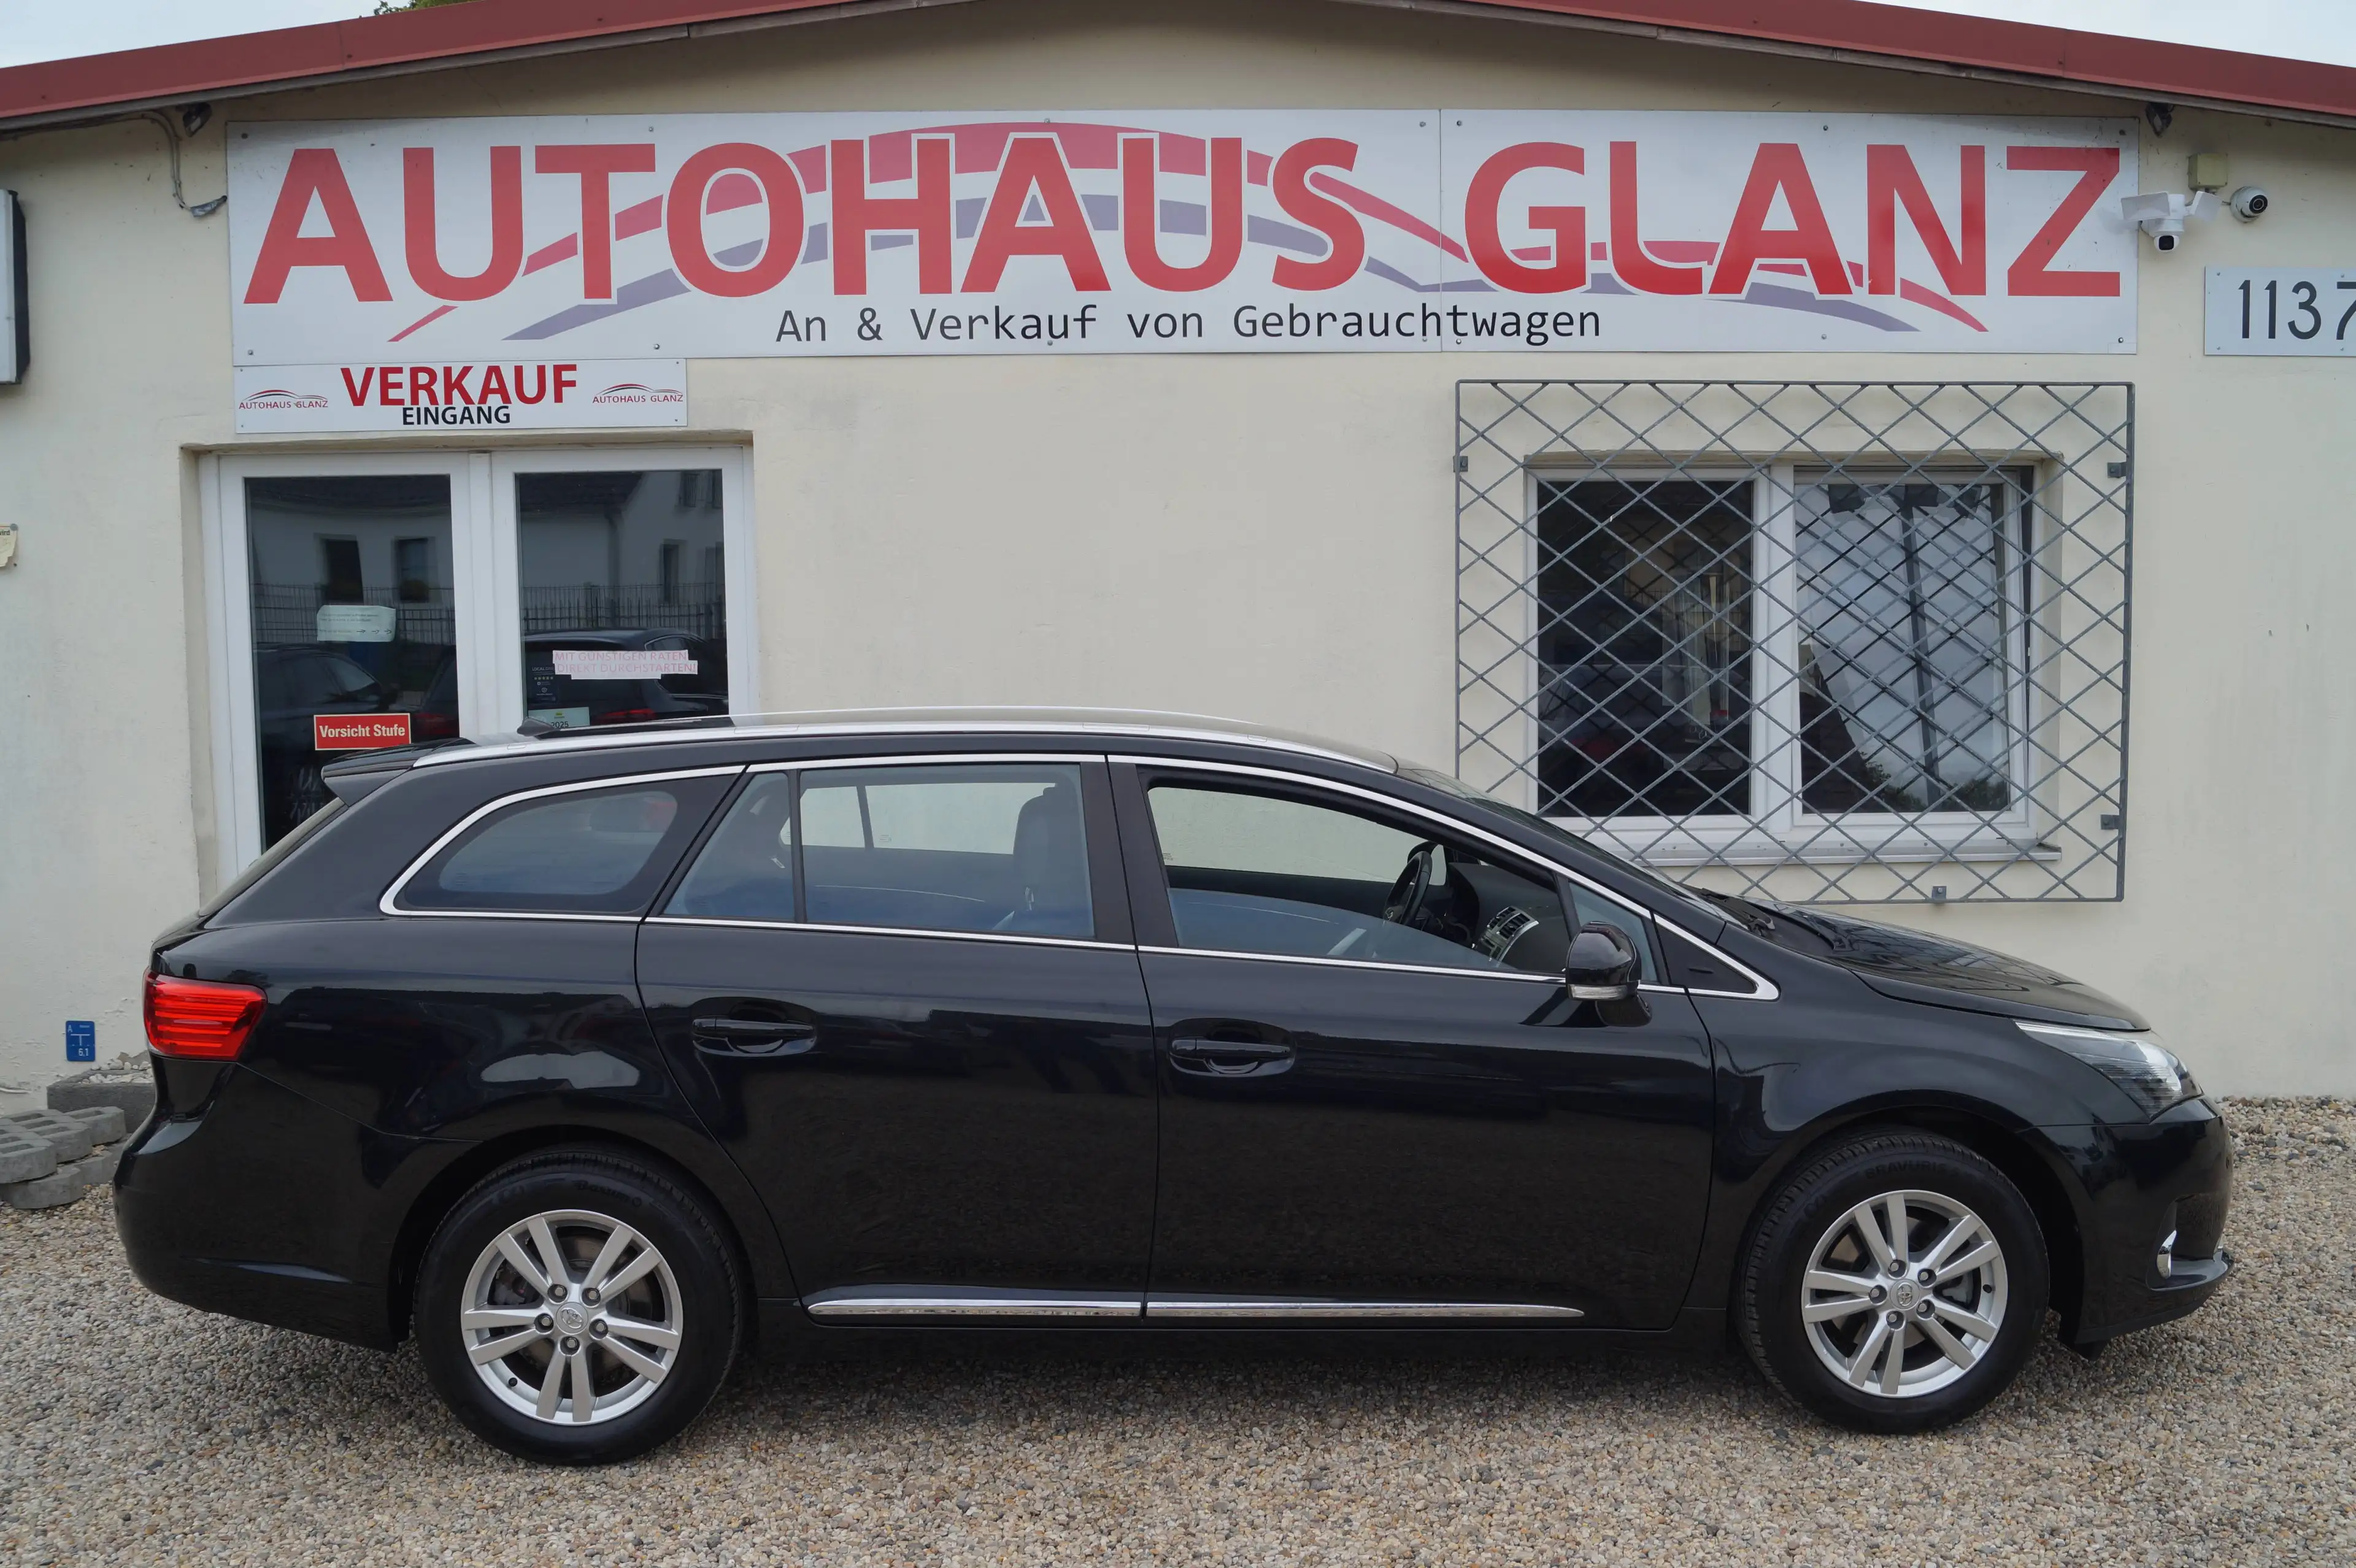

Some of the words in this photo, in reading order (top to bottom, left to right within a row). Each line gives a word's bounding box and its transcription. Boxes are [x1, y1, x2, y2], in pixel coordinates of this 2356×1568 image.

[244, 137, 1365, 304] AUTOHAUS
[1465, 140, 2121, 297] GLANZ
[776, 309, 826, 342] An
[857, 307, 883, 341] &
[910, 304, 1097, 341] Verkauf
[1127, 312, 1203, 339] von
[1233, 303, 1600, 346] Gebrauchtwagen
[341, 364, 577, 407] VERKAUF
[239, 401, 291, 409] AUTOHAUS
[295, 400, 328, 409] GLANZ
[592, 394, 646, 404] AUTOHAUS
[402, 405, 511, 426] EINGANG
[555, 651, 574, 661] MIT
[650, 651, 687, 661] RATEN
[557, 663, 597, 673] DIREKT
[600, 663, 696, 673] DURCHSTARTEN!
[319, 724, 370, 737] Vorsicht
[373, 724, 406, 736] Stufe
[67, 1024, 73, 1032] A
